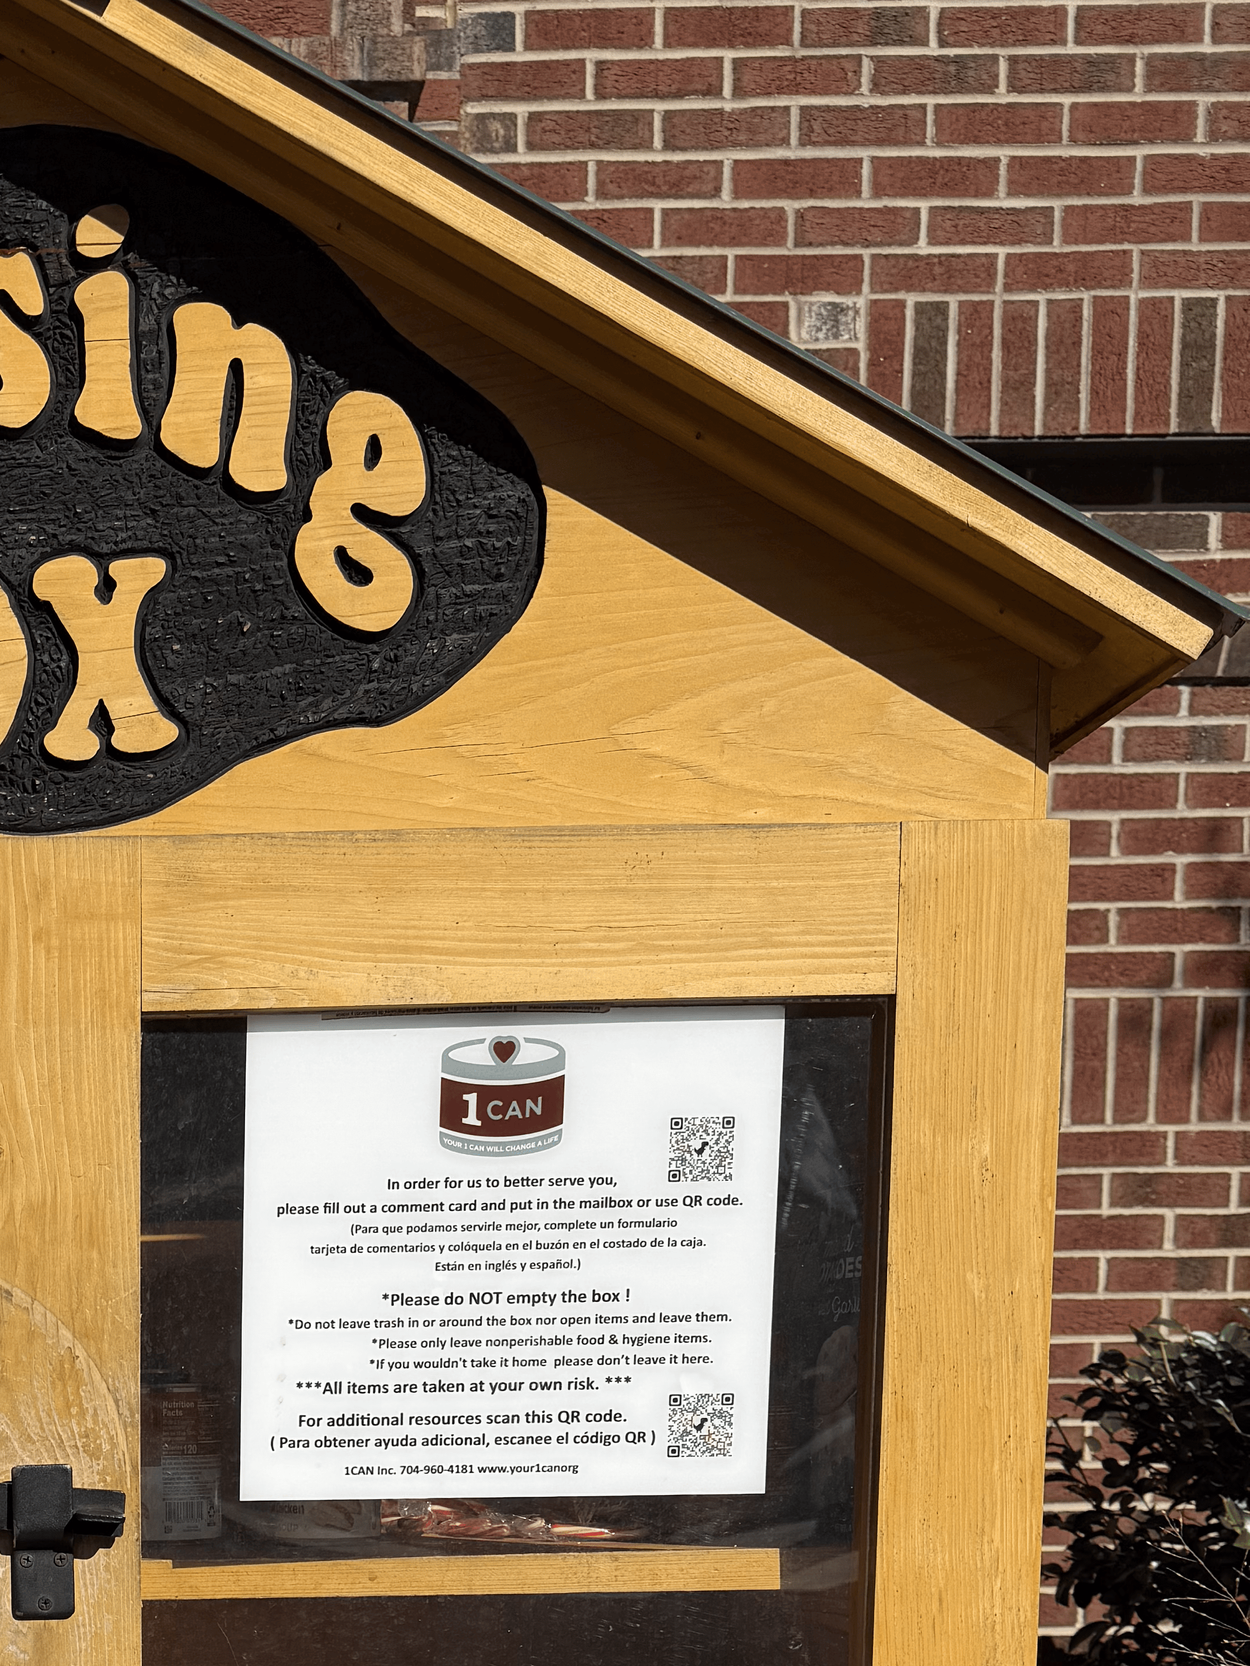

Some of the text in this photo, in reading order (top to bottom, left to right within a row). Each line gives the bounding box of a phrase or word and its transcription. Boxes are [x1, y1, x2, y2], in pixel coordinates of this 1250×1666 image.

[462, 1093, 543, 1126] 1 CAN
[350, 1217, 678, 1236] (Para que podamos servirle mejor, complete un formulario
[420, 1337, 447, 1351] only
[450, 1336, 483, 1348] leave
[485, 1334, 574, 1350] nonperishable
[576, 1333, 605, 1346] food
[608, 1333, 619, 1345] &
[622, 1333, 671, 1347] hygiene
[673, 1332, 712, 1344] items.
[387, 1361, 410, 1372] you
[470, 1356, 497, 1368] take
[499, 1356, 509, 1368] it
[512, 1356, 547, 1368] home
[553, 1355, 594, 1369] please
[633, 1353, 666, 1366] leave
[669, 1353, 679, 1365] it
[681, 1353, 714, 1365] here.
[163, 1409, 183, 1417] Facts
[183, 1444, 197, 1454] 120
[279, 1436, 310, 1449] Para
[314, 1435, 371, 1449] obtener
[374, 1434, 417, 1451] ayuda
[421, 1432, 490, 1448] adicional,
[494, 1435, 552, 1446] escanee
[556, 1431, 569, 1445] el
[573, 1431, 621, 1447] código
[624, 1431, 647, 1445] QR
